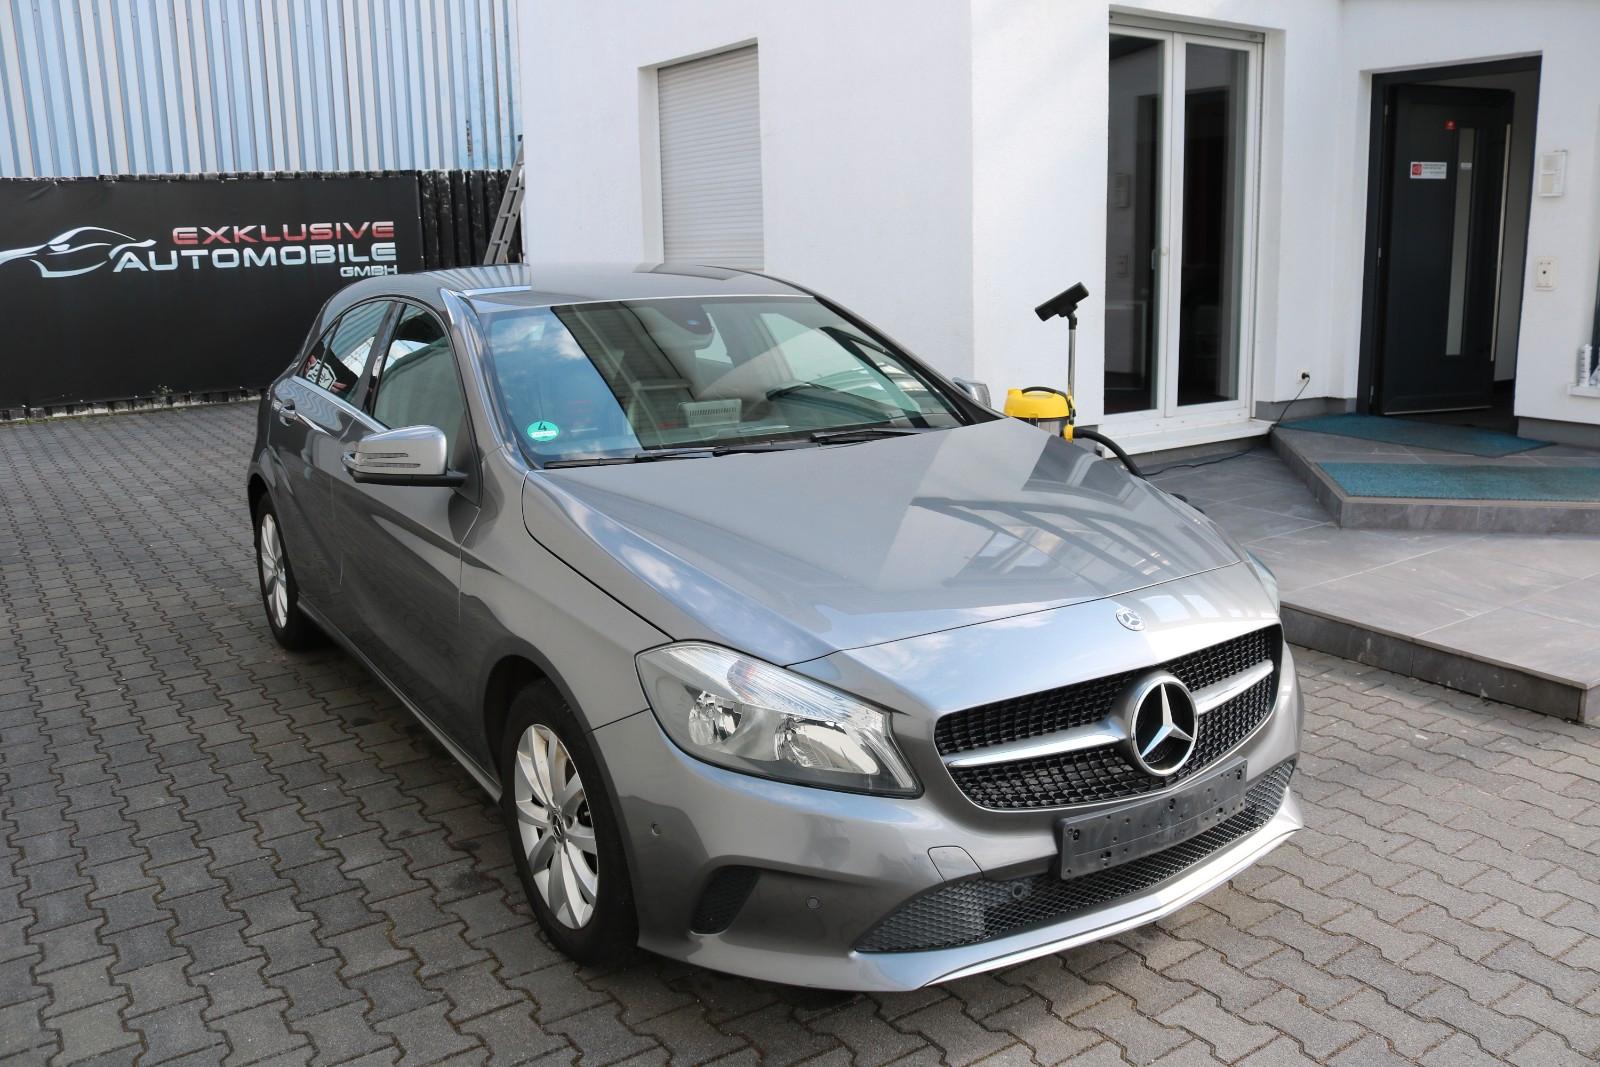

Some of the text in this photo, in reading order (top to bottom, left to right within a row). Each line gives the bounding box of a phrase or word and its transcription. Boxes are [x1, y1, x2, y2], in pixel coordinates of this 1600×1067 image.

[172, 221, 394, 245] EXKLUSIVE
[112, 242, 397, 273] AUTOMOBILE
[340, 264, 398, 278] GMBH
[537, 421, 547, 431] 4
